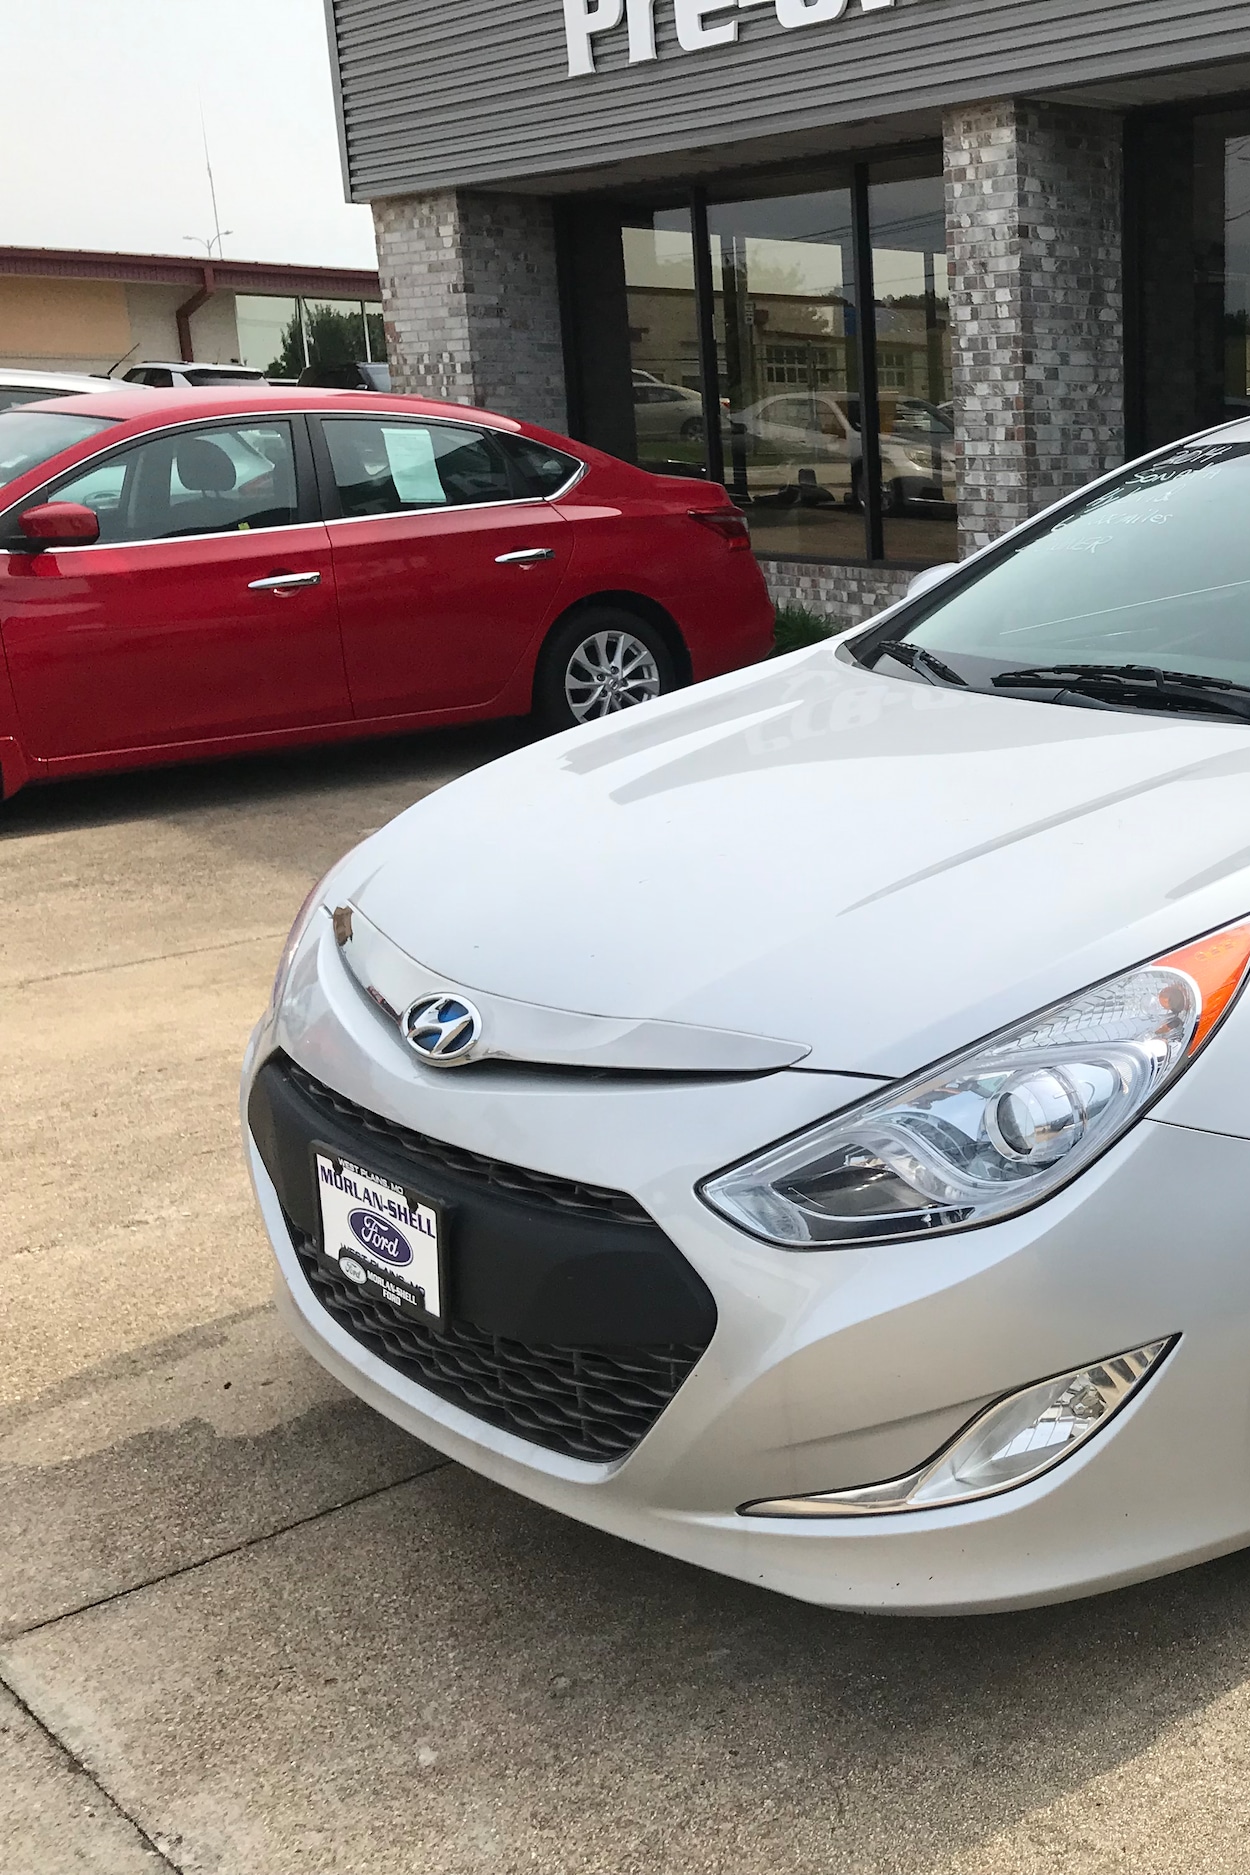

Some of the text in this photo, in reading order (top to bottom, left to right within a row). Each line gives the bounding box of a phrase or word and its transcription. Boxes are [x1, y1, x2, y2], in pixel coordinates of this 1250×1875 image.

[338, 1157, 359, 1174] WEST
[390, 1180, 404, 1195] MO
[320, 1164, 436, 1239] MORLAN-SHELL
[361, 1215, 400, 1258] Ford
[367, 1269, 418, 1306] MORLAN-SHELL
[382, 1288, 402, 1307] FORD
